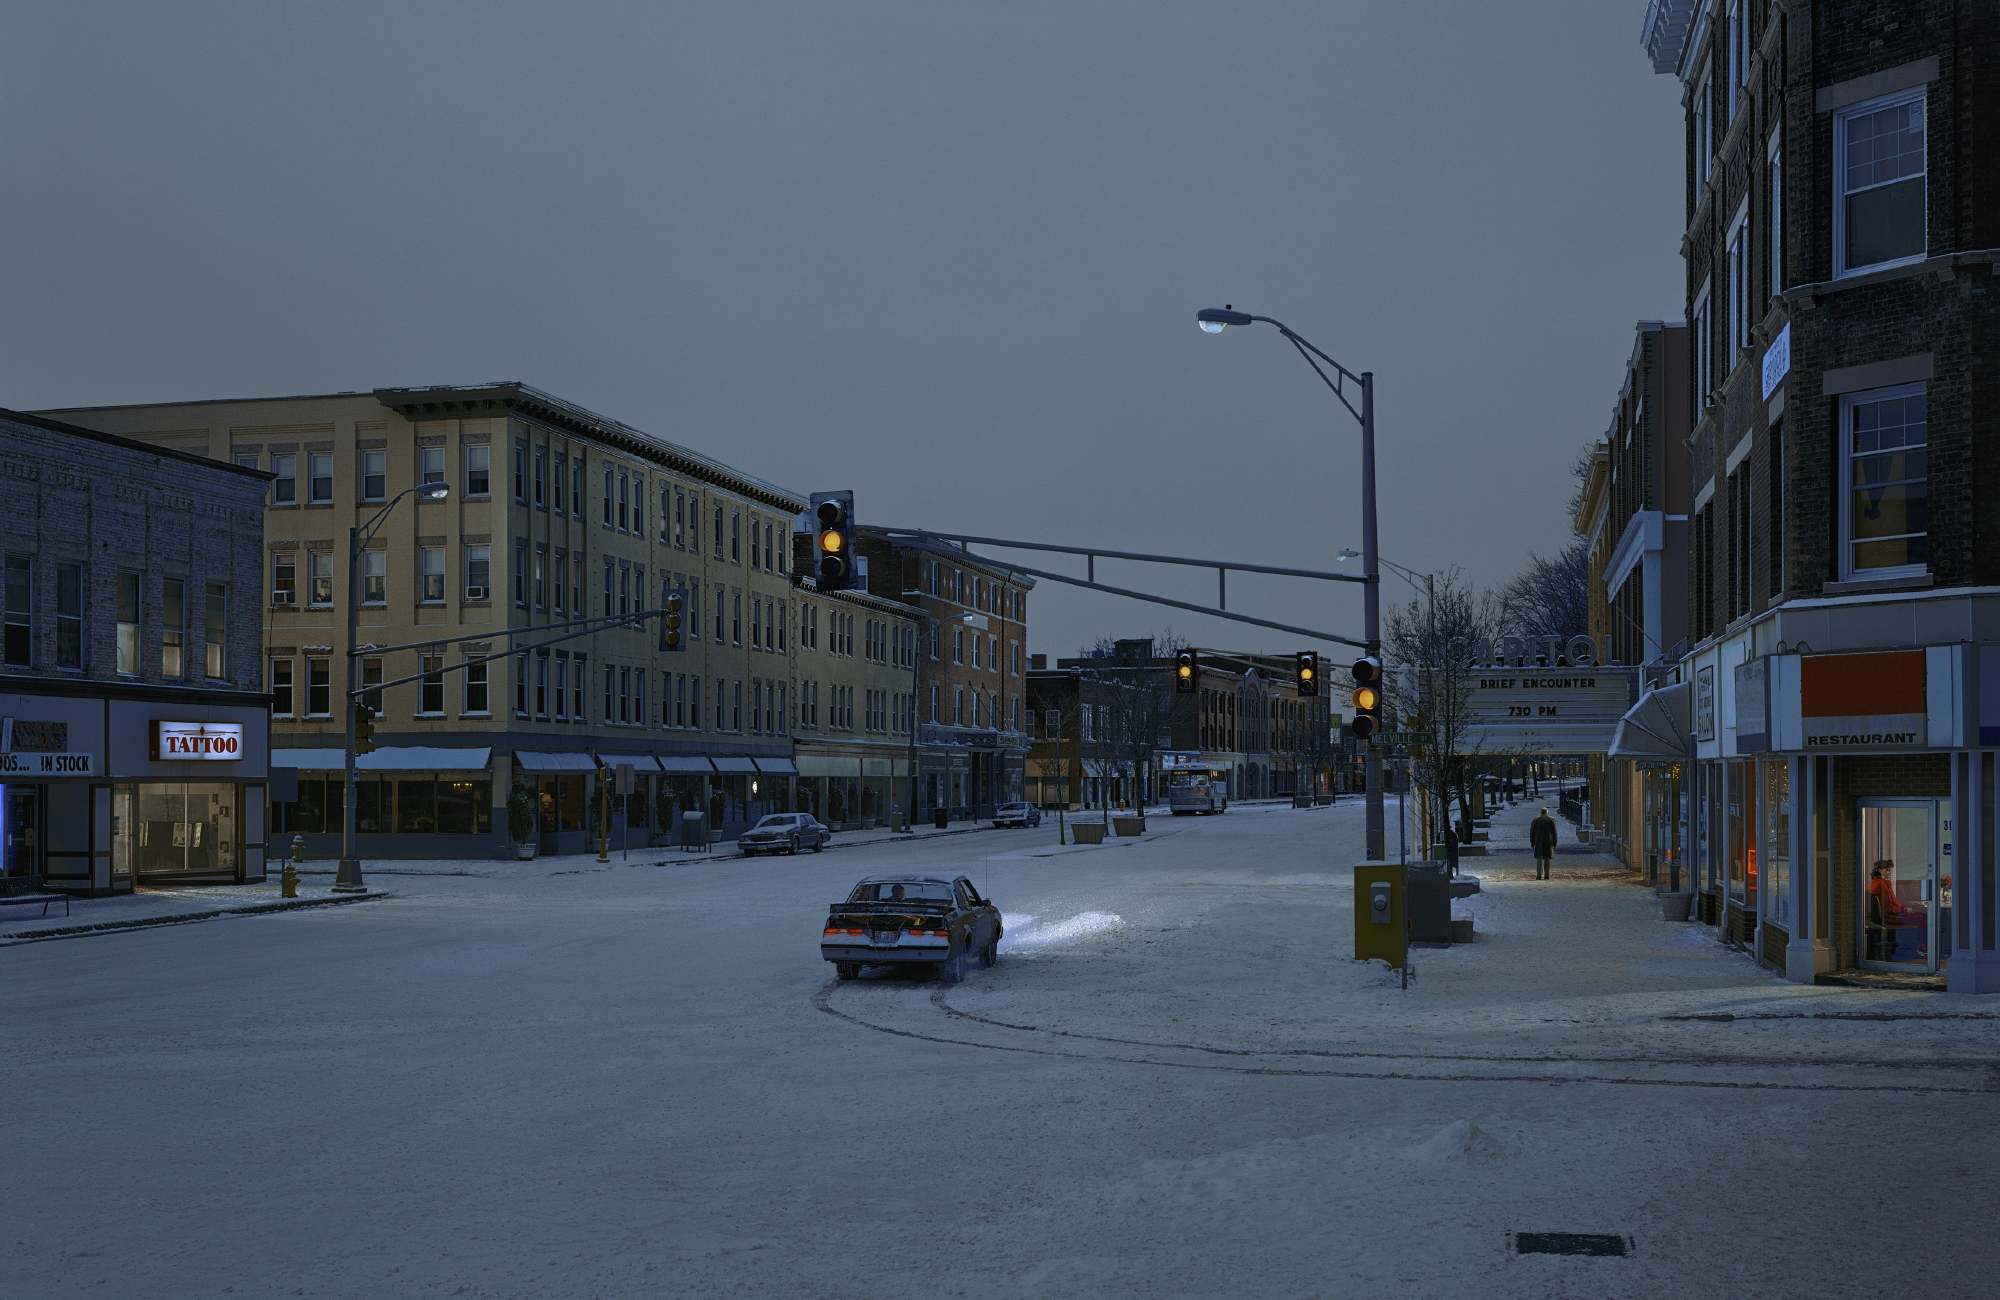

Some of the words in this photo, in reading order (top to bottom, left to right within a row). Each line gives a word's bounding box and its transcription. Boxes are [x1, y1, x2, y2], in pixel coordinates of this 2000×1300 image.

[1480, 678, 1516, 689] BRIEF
[1522, 678, 1595, 689] ENCOUNTER
[1508, 706, 1531, 716] 730
[1538, 706, 1556, 716] PM
[166, 736, 238, 753] TATTOO
[1807, 732, 1917, 746] RESTAURANT
[40, 755, 53, 772] IN
[56, 755, 89, 772] STOCK
